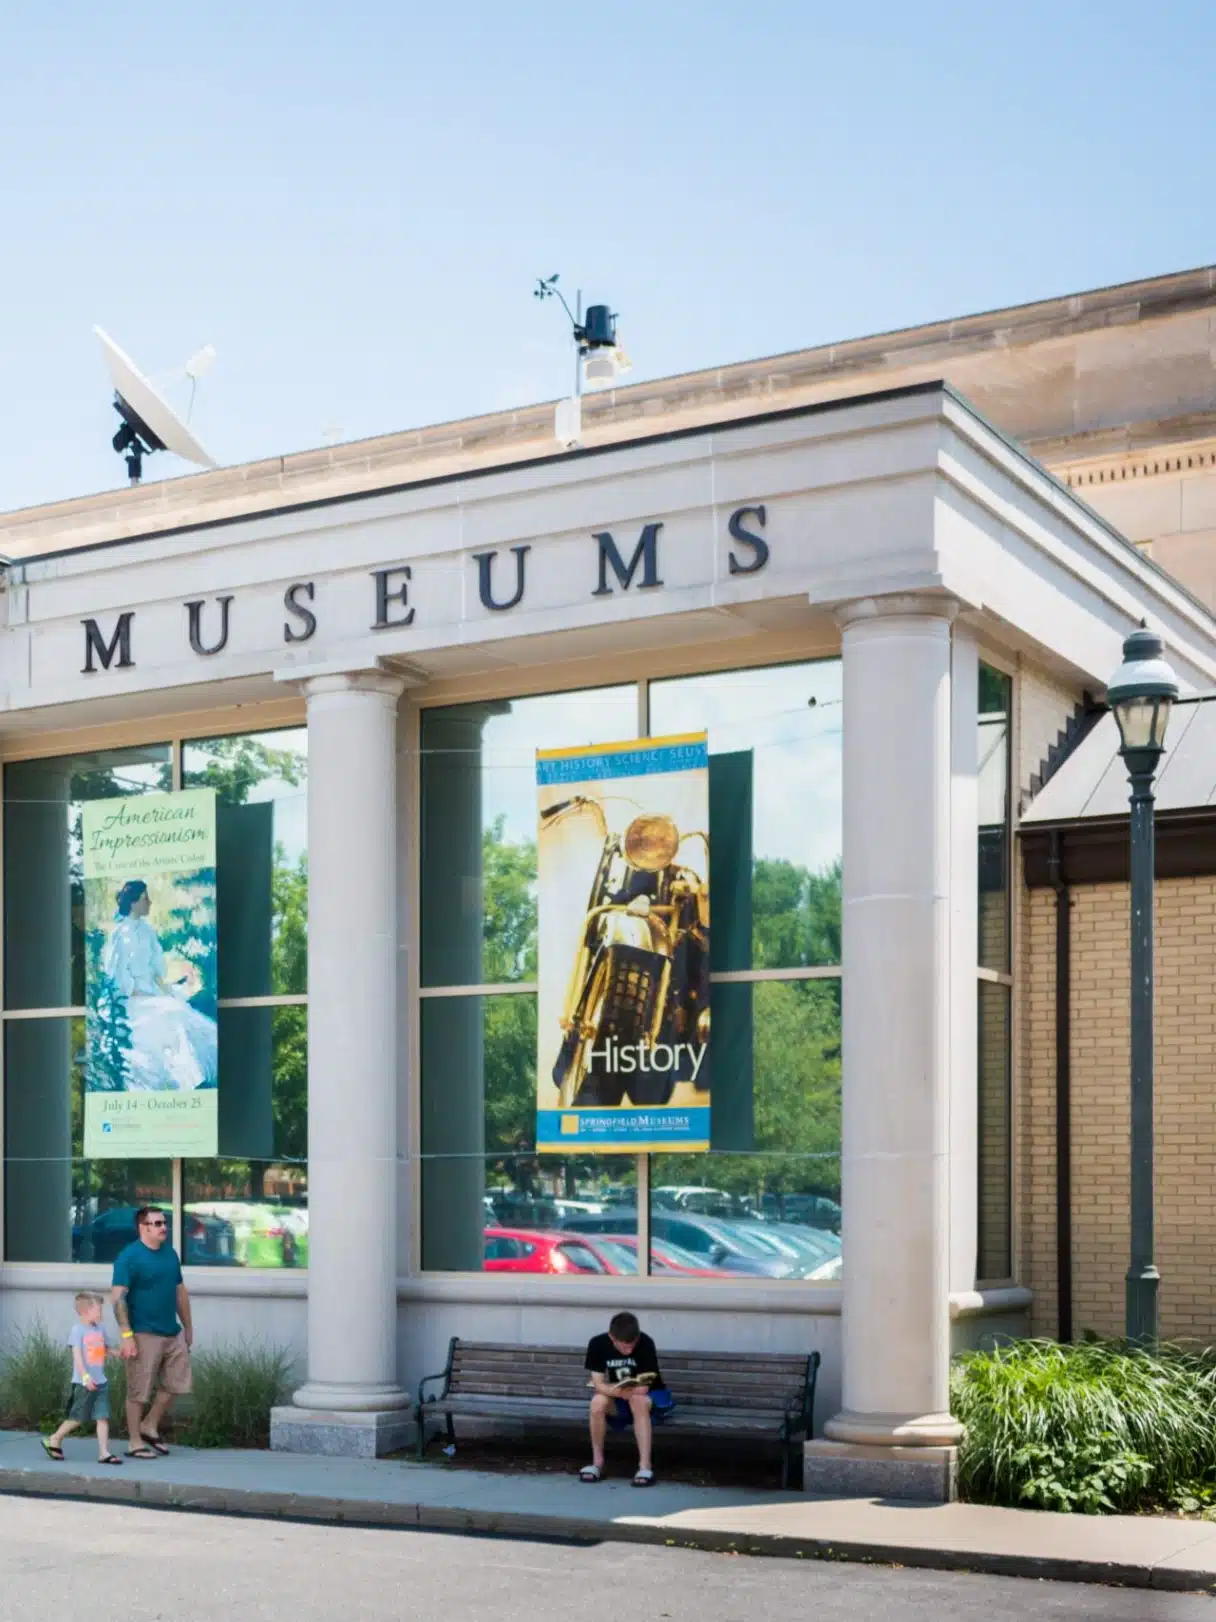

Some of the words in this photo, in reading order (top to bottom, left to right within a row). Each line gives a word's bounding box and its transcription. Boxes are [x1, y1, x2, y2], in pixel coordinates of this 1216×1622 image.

[80, 504, 770, 673] MUSEUMS
[102, 804, 195, 830] American
[90, 827, 206, 858] Impressionism
[585, 1035, 707, 1081] History
[102, 1099, 123, 1113] July
[127, 1099, 138, 1110] 14
[147, 1097, 187, 1110] October
